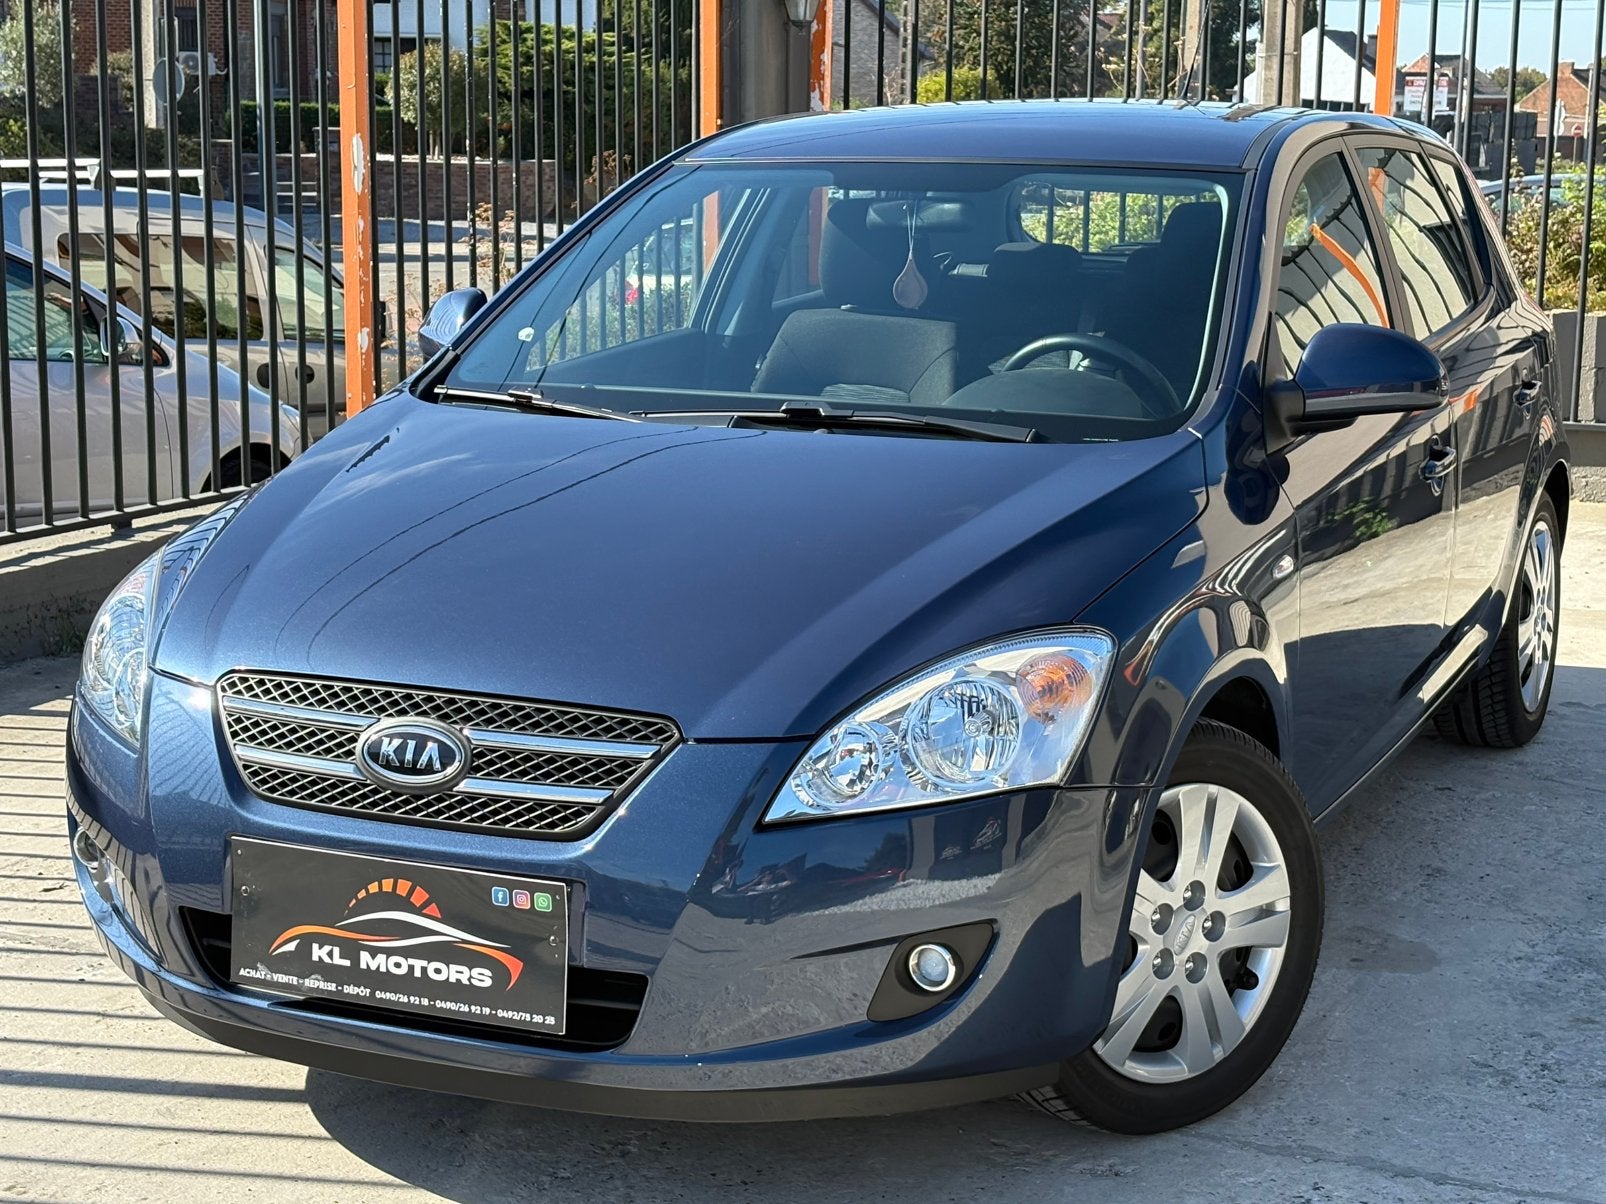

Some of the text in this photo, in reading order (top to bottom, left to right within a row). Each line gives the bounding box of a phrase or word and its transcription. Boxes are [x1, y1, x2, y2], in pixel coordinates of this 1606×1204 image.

[379, 737, 441, 771] KIA
[312, 942, 493, 987] KL MOTORS
[239, 968, 266, 979] ACHAT
[272, 973, 298, 985] VENTE
[304, 978, 337, 991] REPRISE
[343, 984, 371, 997] DÉPÔT
[375, 990, 409, 1003] 0490/26
[409, 995, 420, 1004] 92
[435, 1000, 470, 1012] 0490/26
[470, 1005, 481, 1014] 92
[482, 1007, 491, 1015] 19
[532, 1013, 543, 1023] 20
